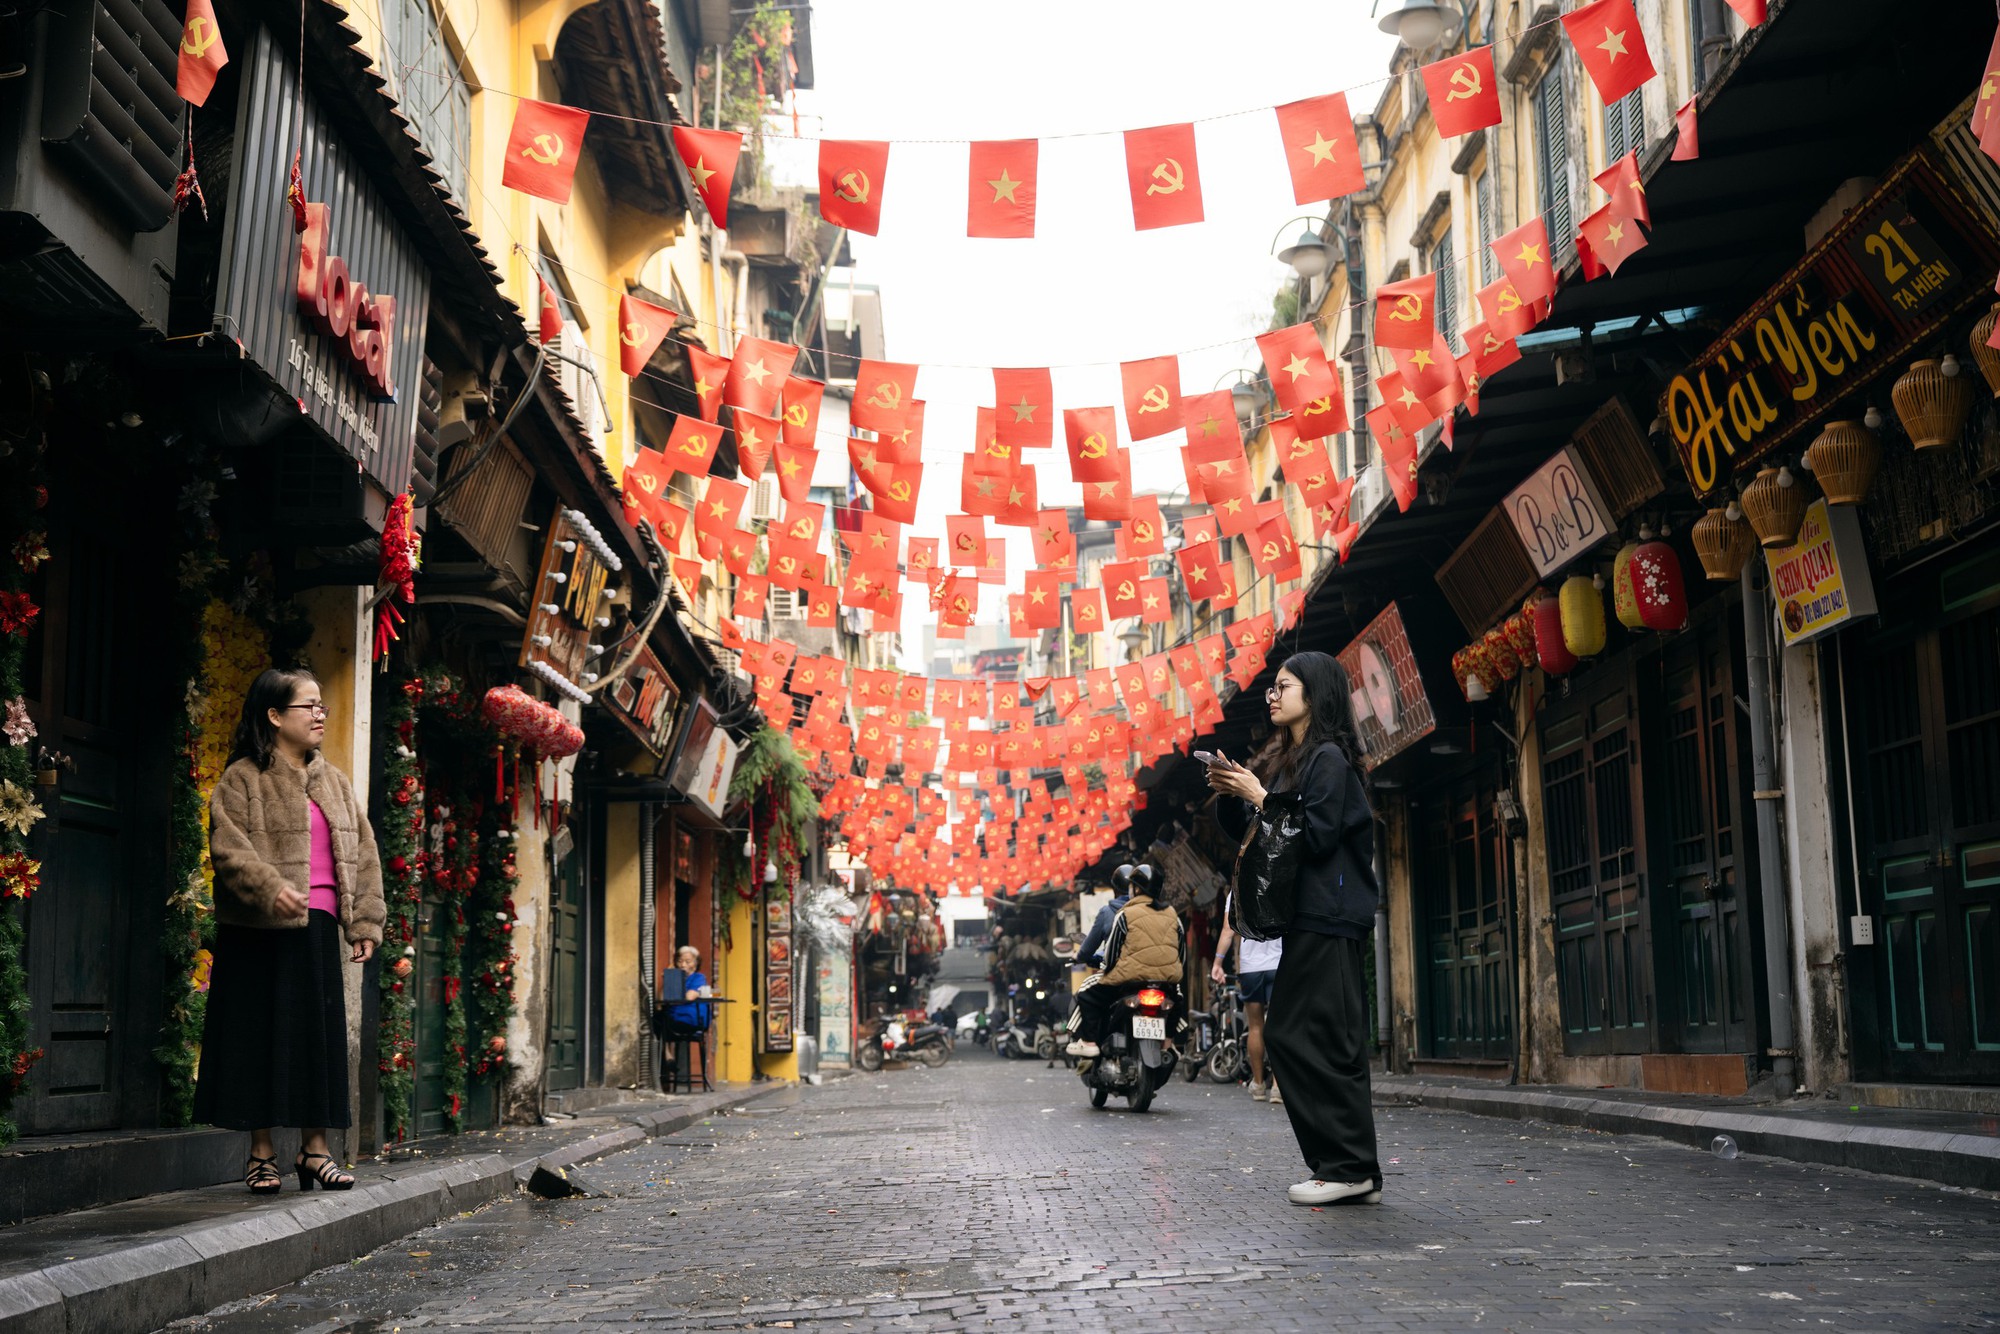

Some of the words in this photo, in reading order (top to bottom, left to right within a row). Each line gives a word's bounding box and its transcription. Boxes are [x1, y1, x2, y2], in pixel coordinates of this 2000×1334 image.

[1864, 219, 1920, 285] 21
[1892, 288, 1918, 310] TẠ
[1910, 260, 1950, 297] HIỆN
[288, 338, 302, 371] 16
[302, 350, 314, 392] Tạ
[314, 366, 333, 407] Hiện
[337, 390, 358, 433] Hoàn
[1668, 339, 1778, 492] Hải
[1755, 282, 1876, 401] Yến
[1775, 557, 1805, 599] CHIM
[1802, 540, 1835, 594] QUAY
